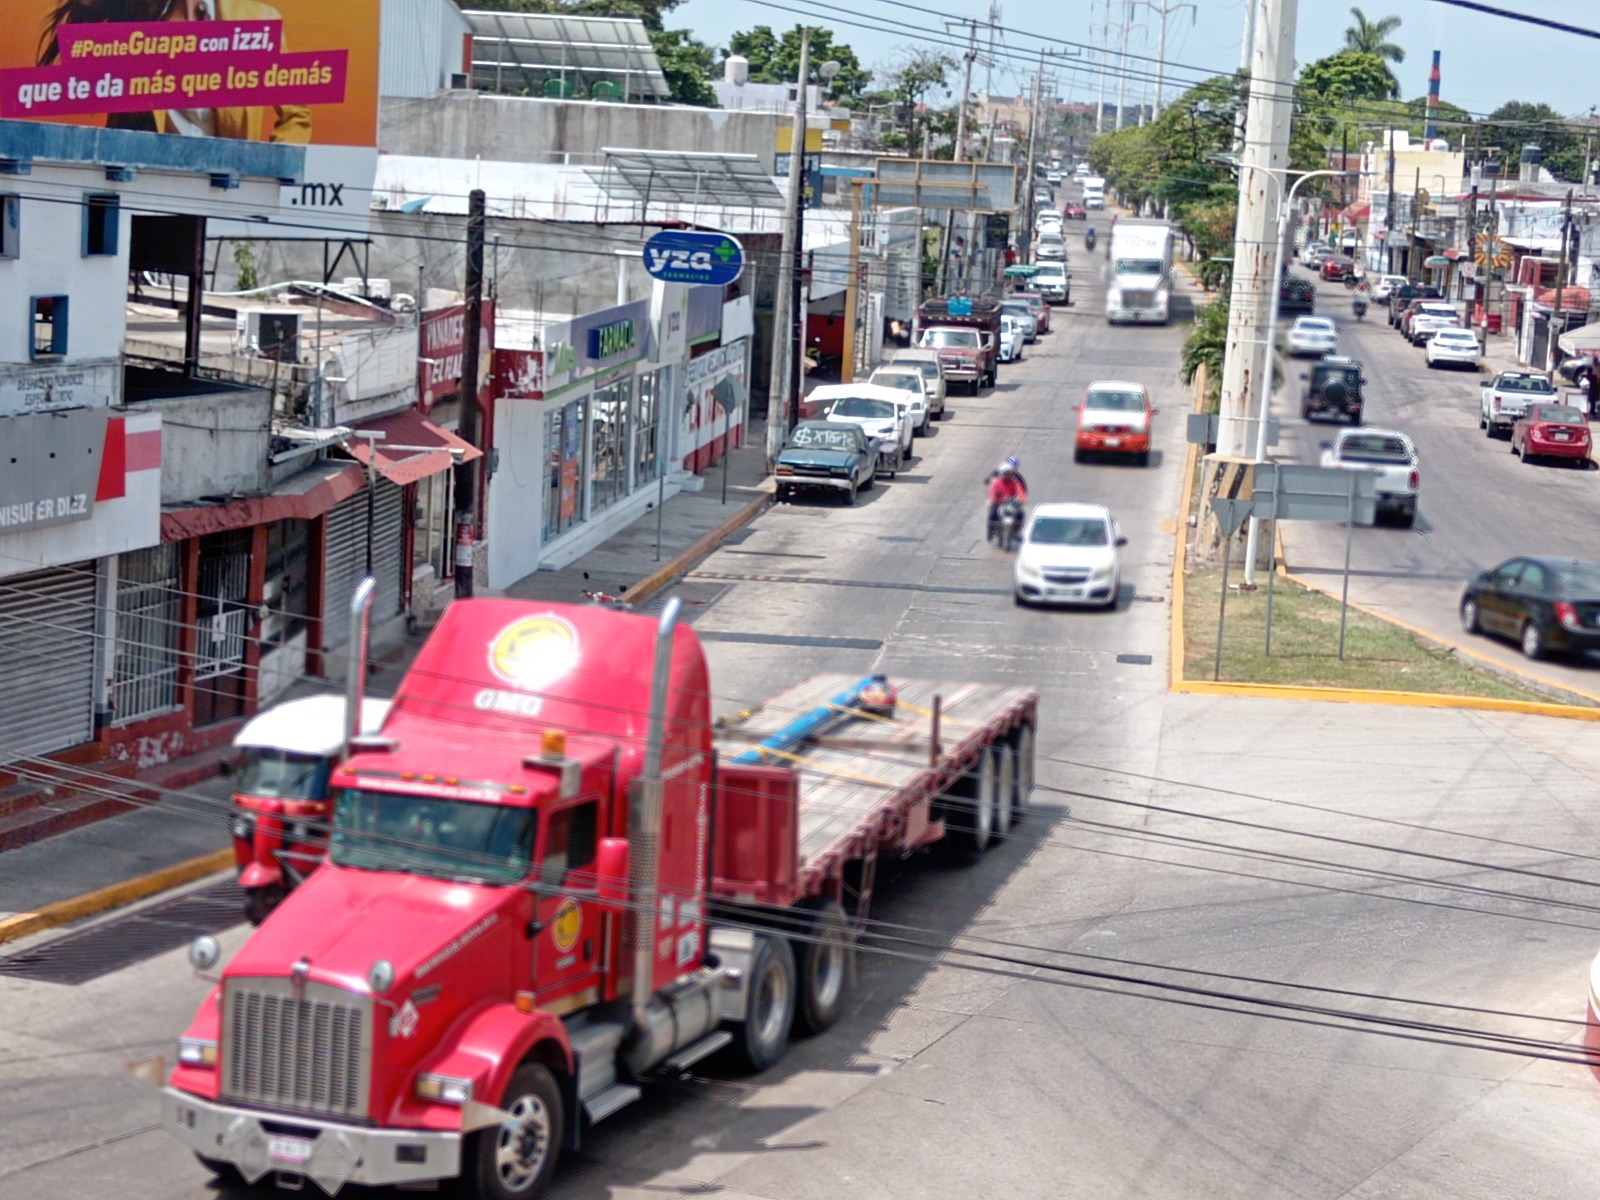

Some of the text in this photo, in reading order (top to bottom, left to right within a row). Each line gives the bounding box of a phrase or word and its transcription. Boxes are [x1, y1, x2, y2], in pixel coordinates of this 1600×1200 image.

[71, 27, 274, 58] #PonteGuapa con izzi,
[18, 61, 332, 108] que te da más que los demás
[292, 183, 344, 206] .mx
[649, 248, 713, 273] yza
